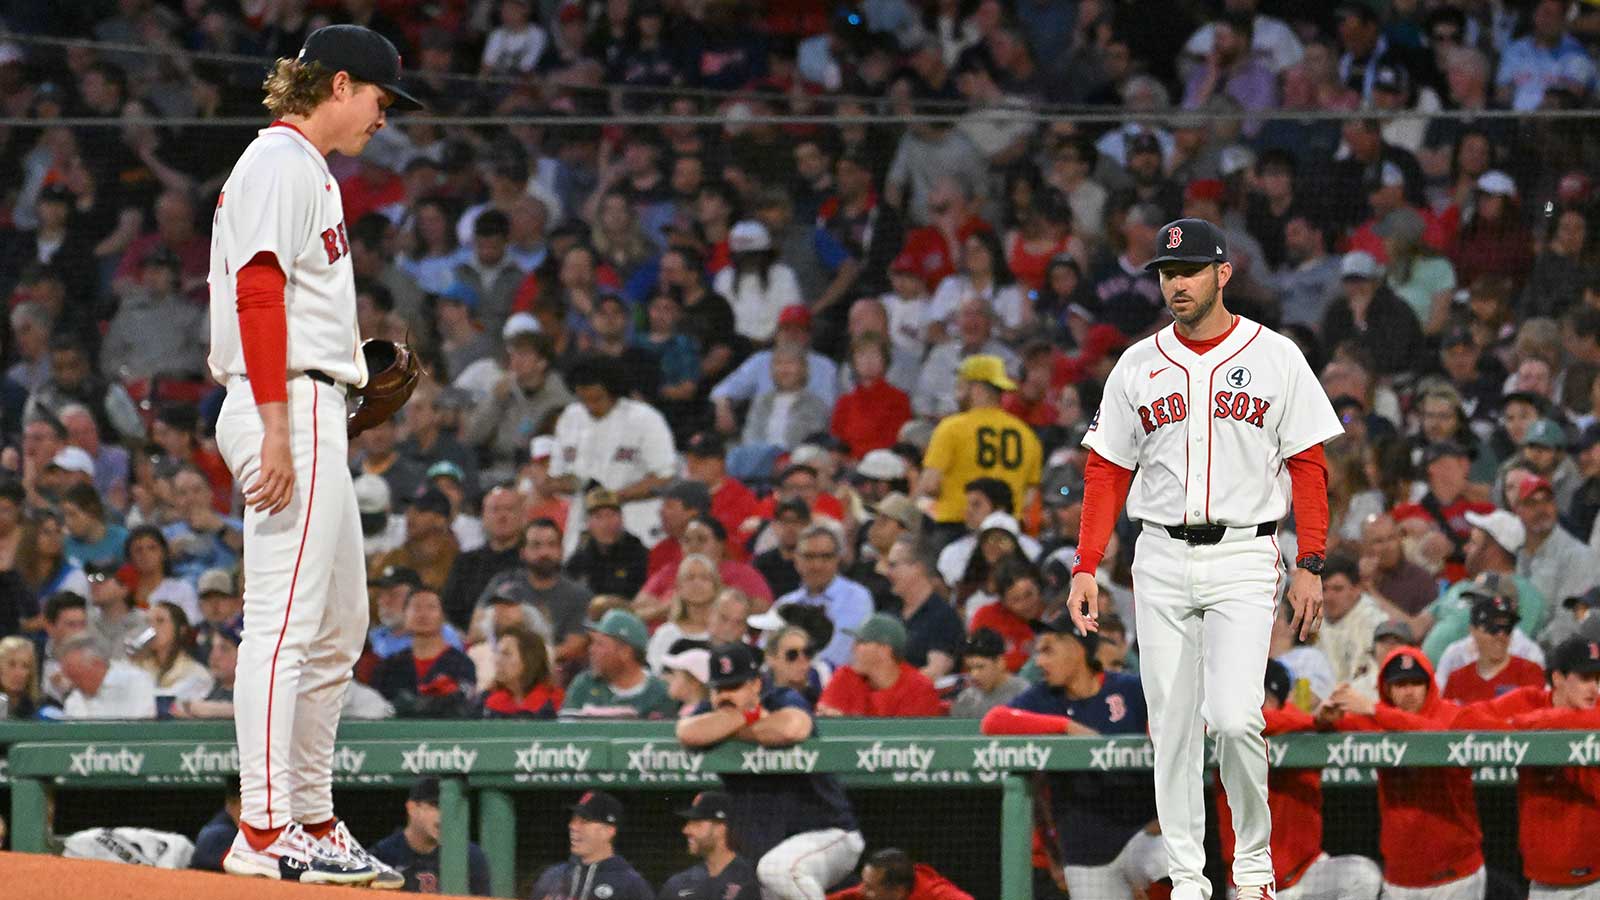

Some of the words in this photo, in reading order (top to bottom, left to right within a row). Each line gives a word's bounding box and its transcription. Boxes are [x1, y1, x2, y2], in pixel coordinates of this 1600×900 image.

[1166, 226, 1183, 249] B
[1231, 368, 1244, 386] 4
[1137, 392, 1187, 436] RED
[1214, 391, 1271, 428] SOX
[977, 426, 1023, 470] 60
[70, 745, 145, 776] xfinity
[180, 744, 239, 774] xfinit
[402, 742, 478, 774] xfinity
[514, 740, 591, 773] xfinity
[628, 742, 704, 773] xfinity
[741, 745, 819, 773] xfinity
[856, 740, 936, 772] xfinity
[973, 740, 1052, 770] xfinity
[1089, 739, 1154, 771] xfinit
[1327, 735, 1408, 767] xfinity
[1447, 733, 1530, 766] xfinity
